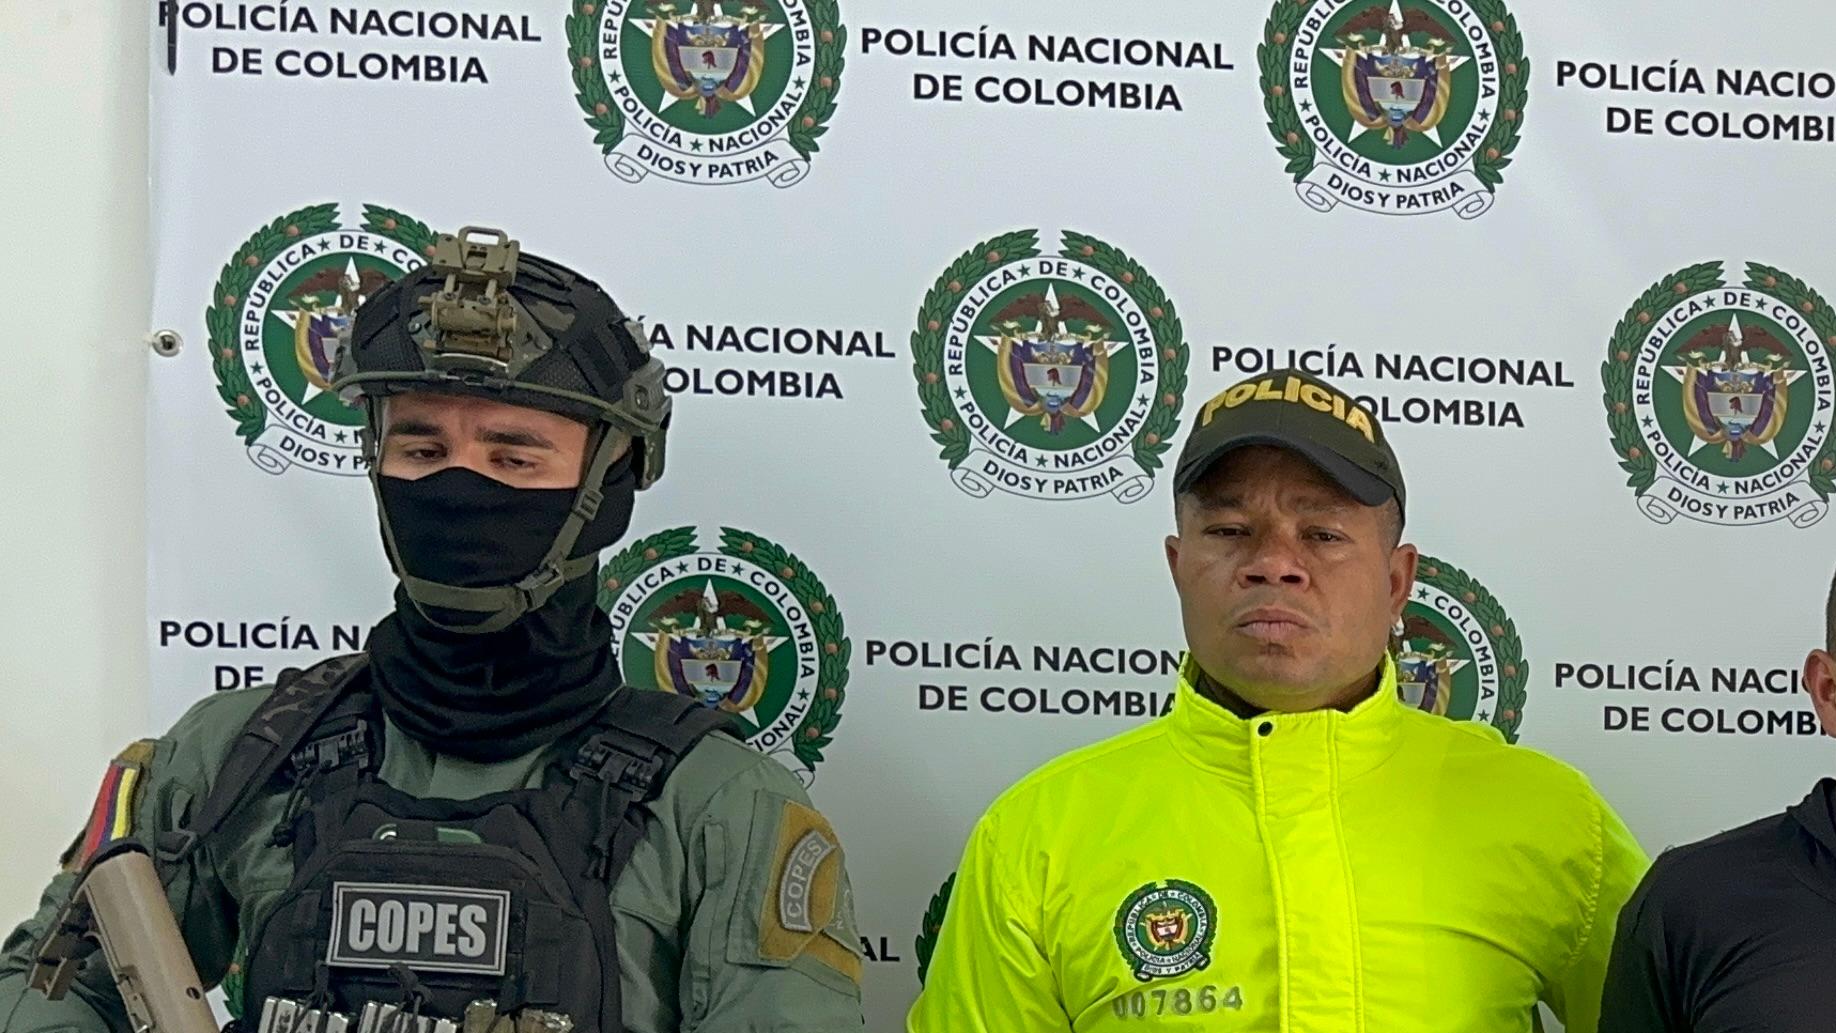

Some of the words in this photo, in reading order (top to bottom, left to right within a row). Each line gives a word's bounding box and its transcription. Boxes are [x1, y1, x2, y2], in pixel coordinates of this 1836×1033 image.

[331, 8, 541, 41] NACIONAL
[862, 25, 1014, 59] POLICÍA
[1029, 35, 1233, 69] NACIONAL
[213, 47, 262, 74] DE
[276, 50, 488, 83] COLOMBIA
[1558, 60, 1705, 93] POLICÍA
[914, 74, 962, 101] DE
[975, 77, 1182, 111] COLOMBIA
[709, 93, 801, 152] NACIONAL
[1607, 107, 1653, 134] DE
[637, 144, 685, 175] DIOS
[689, 162, 702, 177] Y
[708, 151, 778, 178] PATRIA
[948, 270, 1016, 375] REPÚBLICA
[1040, 261, 1067, 276] DE
[1092, 276, 1154, 384] COLOMBIA
[687, 325, 895, 357] NACIONAL
[1636, 301, 1702, 404] REPÚBLICA
[1725, 292, 1750, 306] DE
[1773, 306, 1831, 411] COLOMBIA
[666, 368, 843, 398] OLOMBIA
[1376, 354, 1574, 387] NACIONAL
[1202, 375, 1375, 444] POLICIA
[1356, 396, 1525, 428] OLOMBIA
[1054, 410, 1145, 468] NACIONAL
[983, 460, 1031, 490] DIOS
[1035, 478, 1048, 492] Y
[1054, 467, 1123, 493] PATRIA
[1735, 437, 1821, 494] NACIONAL
[1667, 487, 1712, 516] DIOS
[1716, 504, 1728, 518] Y
[1734, 493, 1799, 518] PATRIA
[161, 616, 319, 650] POLICÍA
[867, 637, 1019, 670] POLICÍA
[1034, 645, 1185, 675] NACION
[1556, 659, 1700, 691] POLICÍA
[920, 685, 967, 710] DE
[1605, 706, 1649, 731] DE
[1661, 706, 1826, 735] COLOMB
[787, 839, 822, 919] COPES
[349, 899, 487, 957] COPES
